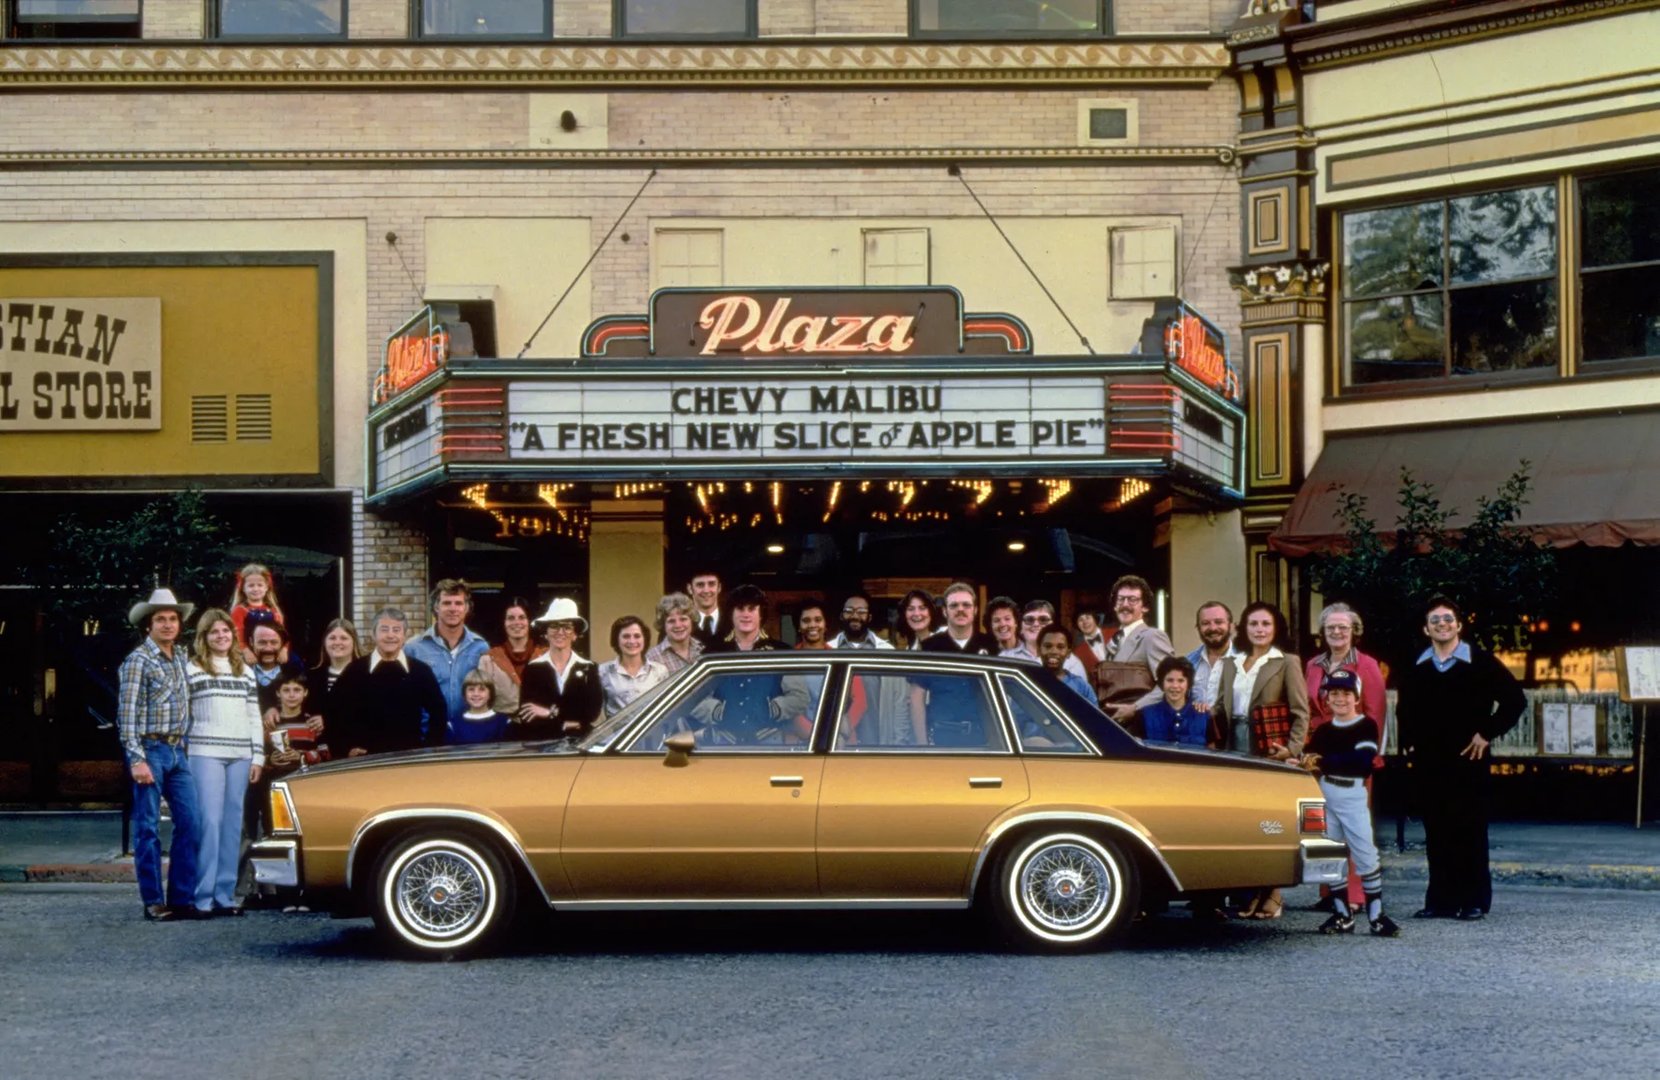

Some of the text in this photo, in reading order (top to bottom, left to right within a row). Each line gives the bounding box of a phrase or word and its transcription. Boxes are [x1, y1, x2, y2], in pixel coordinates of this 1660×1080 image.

[0, 303, 127, 366] TIAN
[698, 295, 915, 355] Plaza
[33, 371, 152, 419] STORE
[671, 385, 942, 415] CHEVY MALIBU
[558, 422, 671, 451] FRESH
[686, 422, 761, 451] NEW
[774, 421, 872, 449] SLICE
[907, 420, 1016, 449] APPLE
